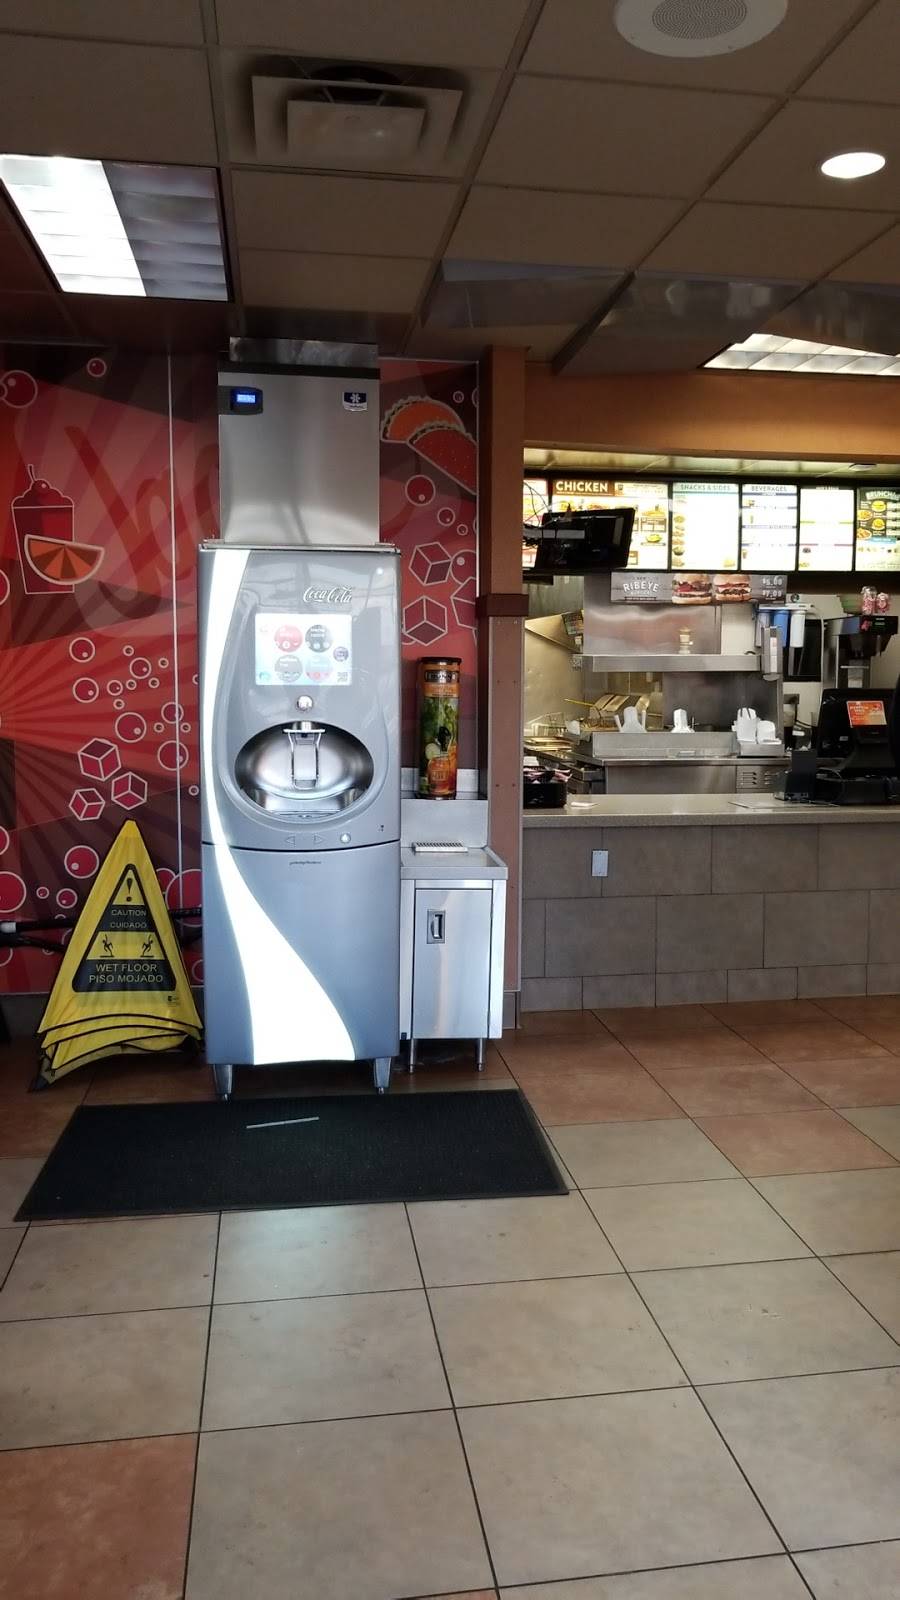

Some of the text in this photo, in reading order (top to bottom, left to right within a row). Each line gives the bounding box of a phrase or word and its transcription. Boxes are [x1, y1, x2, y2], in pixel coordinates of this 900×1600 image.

[555, 480, 608, 493] CHICKEN
[623, 580, 660, 592] RIBEYE
[111, 909, 147, 917] CAUTION
[110, 921, 147, 929] CUIDADO
[95, 963, 158, 972] WET FLOOR
[89, 974, 164, 984] PISO MOJADO
